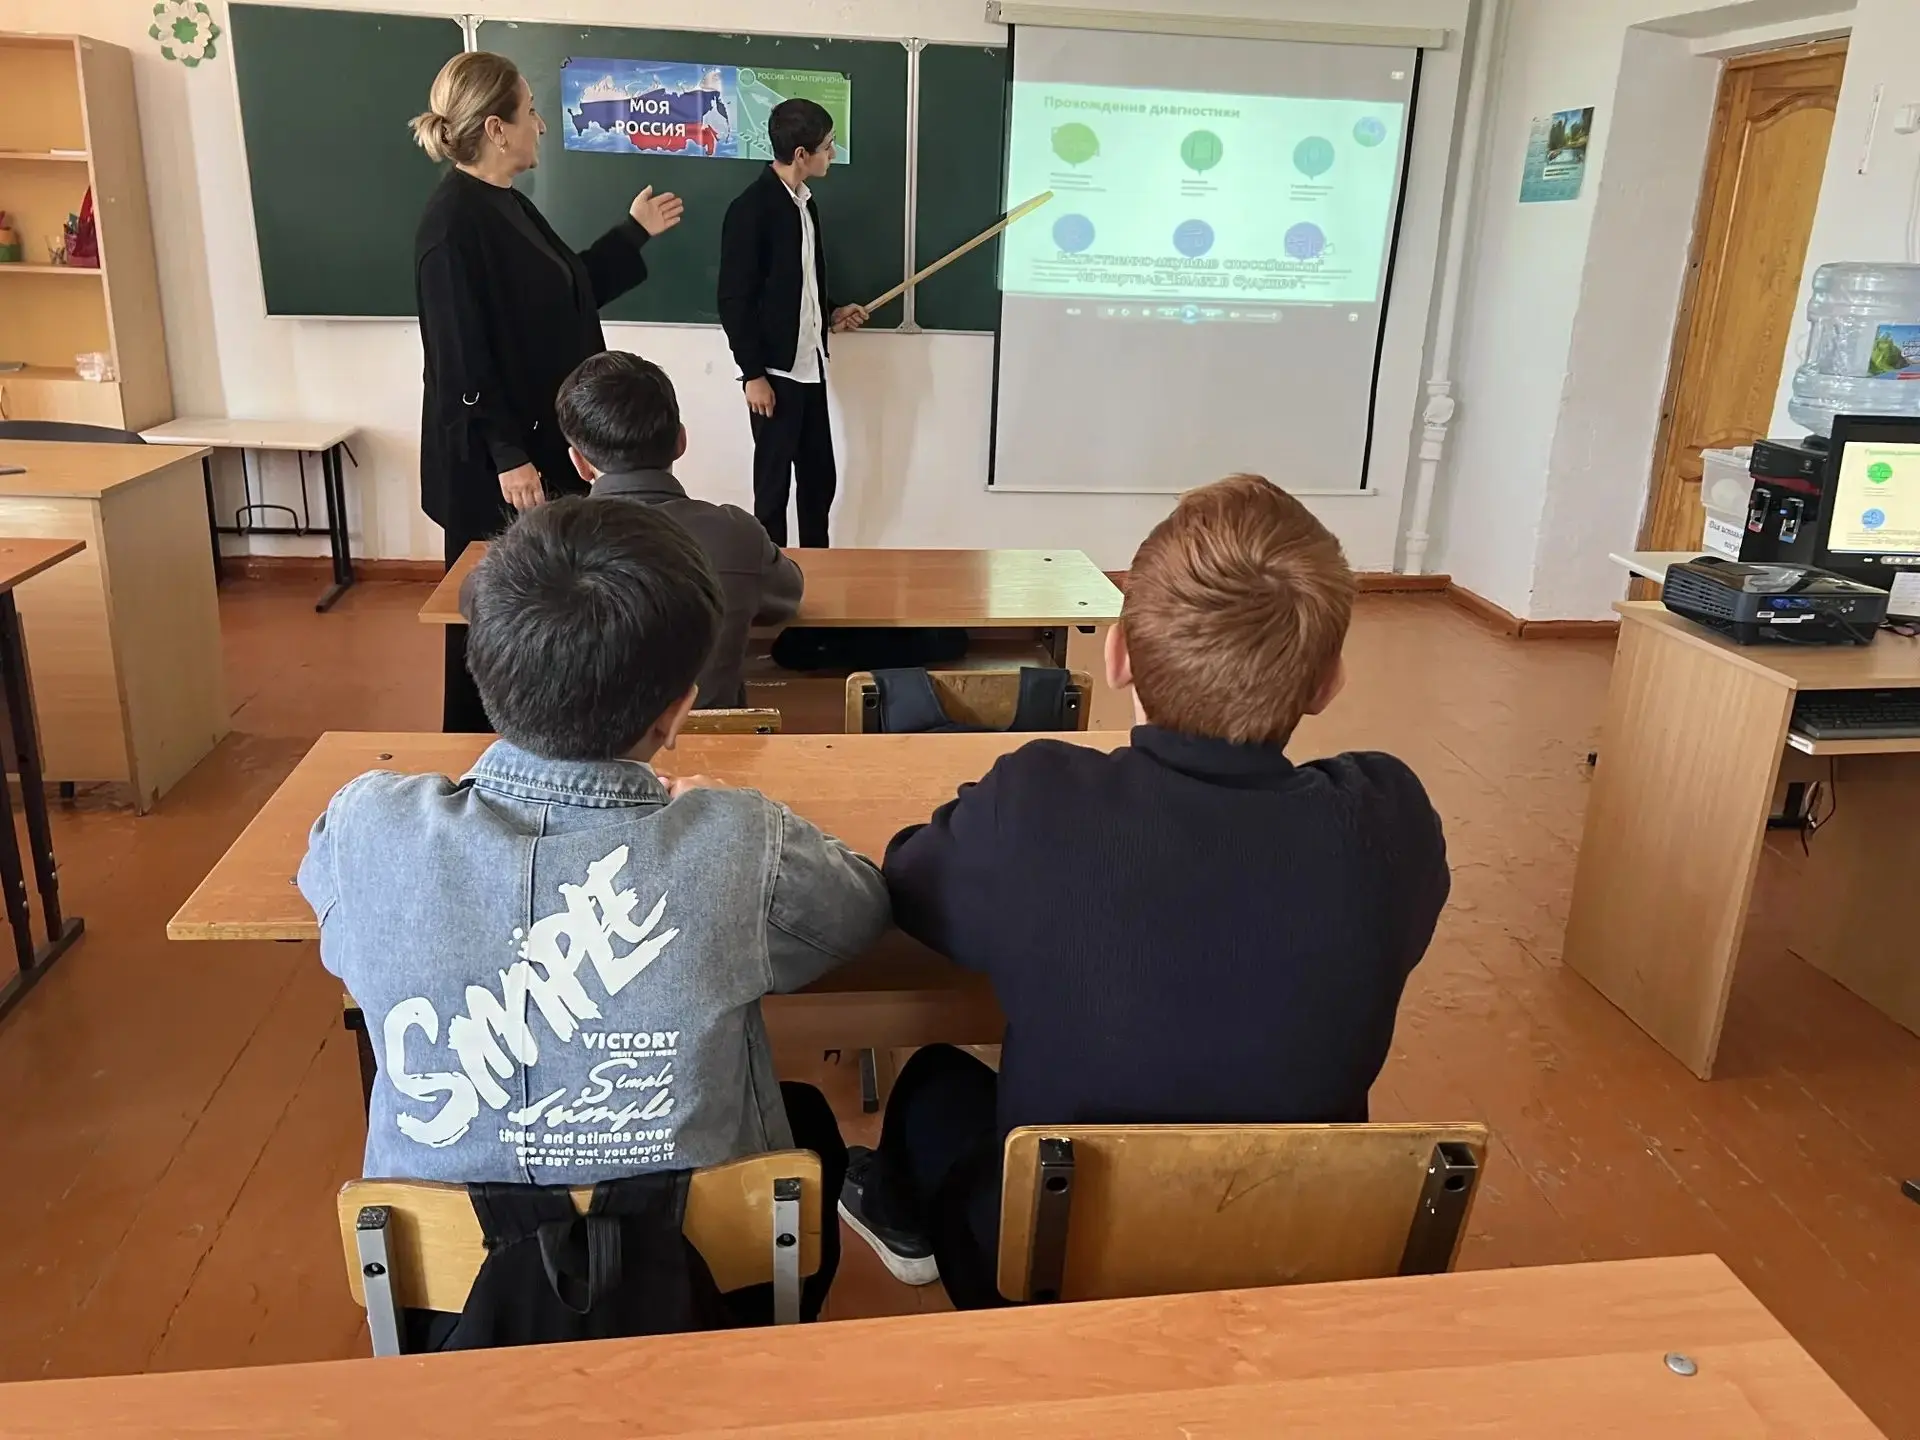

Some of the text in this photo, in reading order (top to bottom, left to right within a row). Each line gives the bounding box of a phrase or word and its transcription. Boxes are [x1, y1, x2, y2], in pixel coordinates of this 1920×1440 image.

[757, 72, 784, 81] РОССИЯ
[630, 99, 670, 115] МОЯ
[1044, 95, 1241, 119] Прохождение диагностики
[615, 120, 686, 137] РОССИЯ
[581, 1030, 680, 1050] VICTORY
[542, 1131, 574, 1144] and
[635, 1128, 672, 1142] over
[604, 1146, 628, 1158] you
[518, 1157, 543, 1167] THE
[574, 1157, 594, 1166] ON
